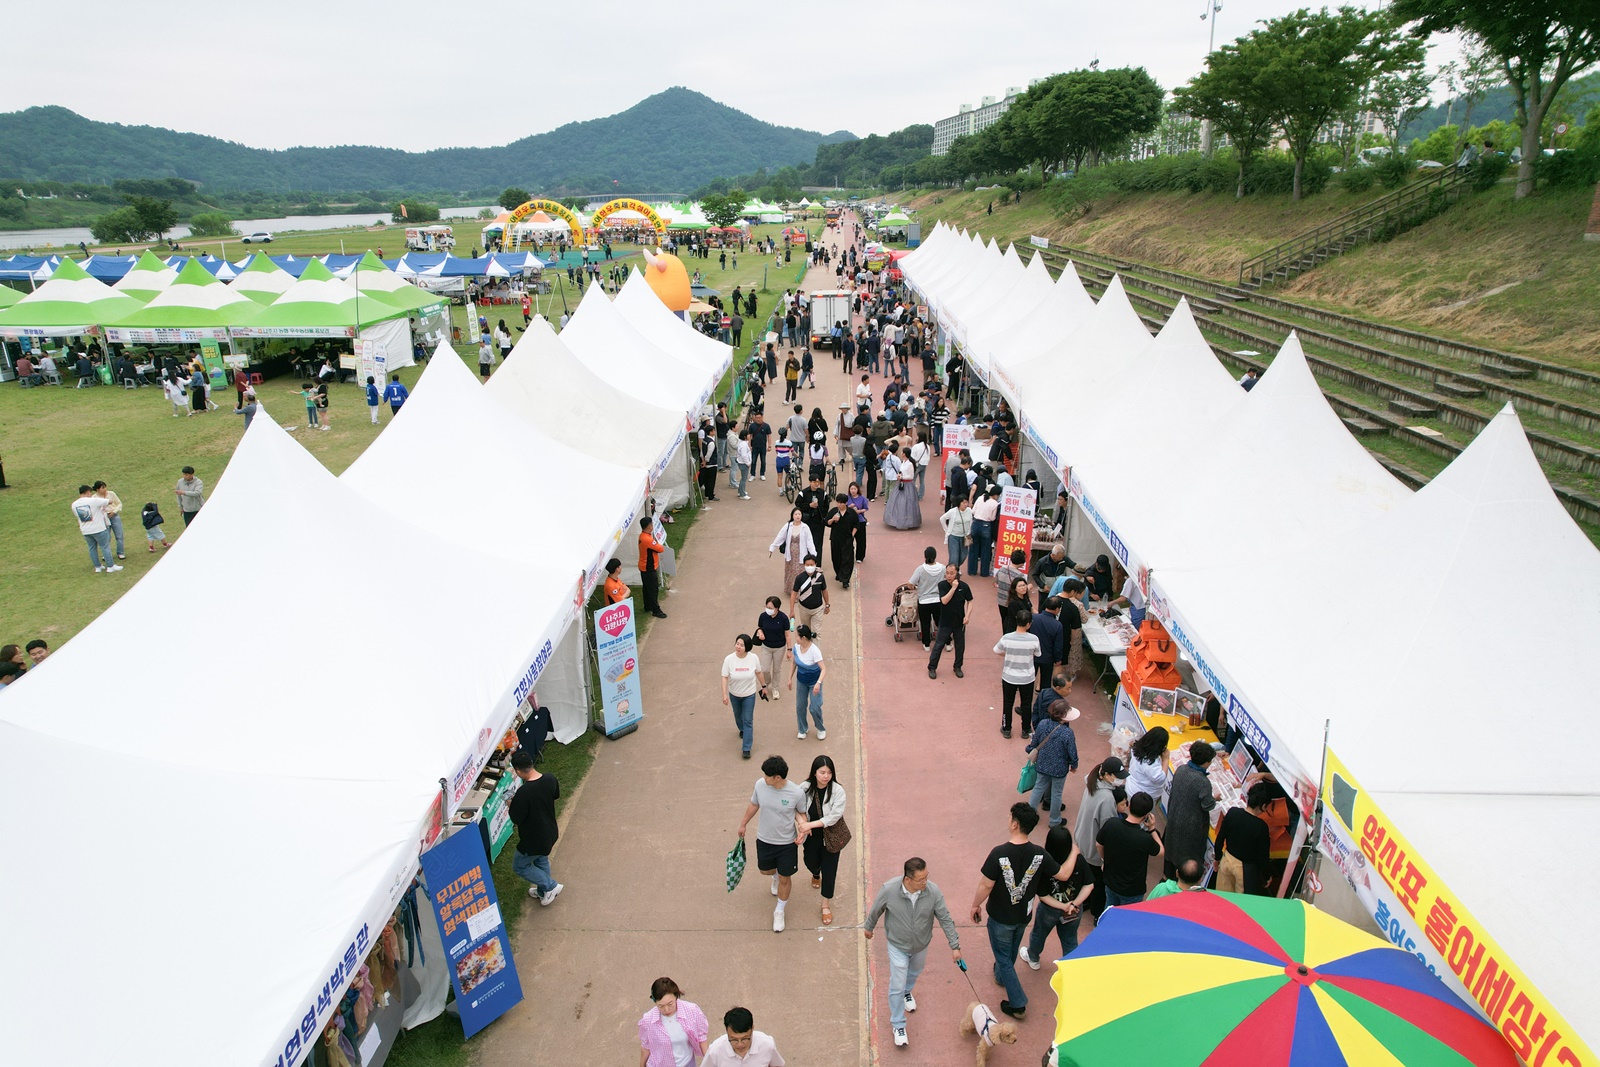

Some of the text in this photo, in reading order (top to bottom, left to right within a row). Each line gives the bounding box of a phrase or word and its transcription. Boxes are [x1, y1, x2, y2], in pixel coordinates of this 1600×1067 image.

[392, 387, 397, 396] 1
[1005, 497, 1019, 506] 홍어
[1004, 505, 1031, 516] 한우 축제
[1005, 519, 1027, 532] 홍어
[1002, 531, 1027, 545] 50%
[603, 616, 628, 631] 고향사랑
[605, 610, 625, 624] 나주시
[1360, 814, 1428, 919] 영산포
[436, 865, 482, 904] 무지개빛
[439, 880, 487, 922] 알록달록
[442, 895, 491, 937] 염색체험
